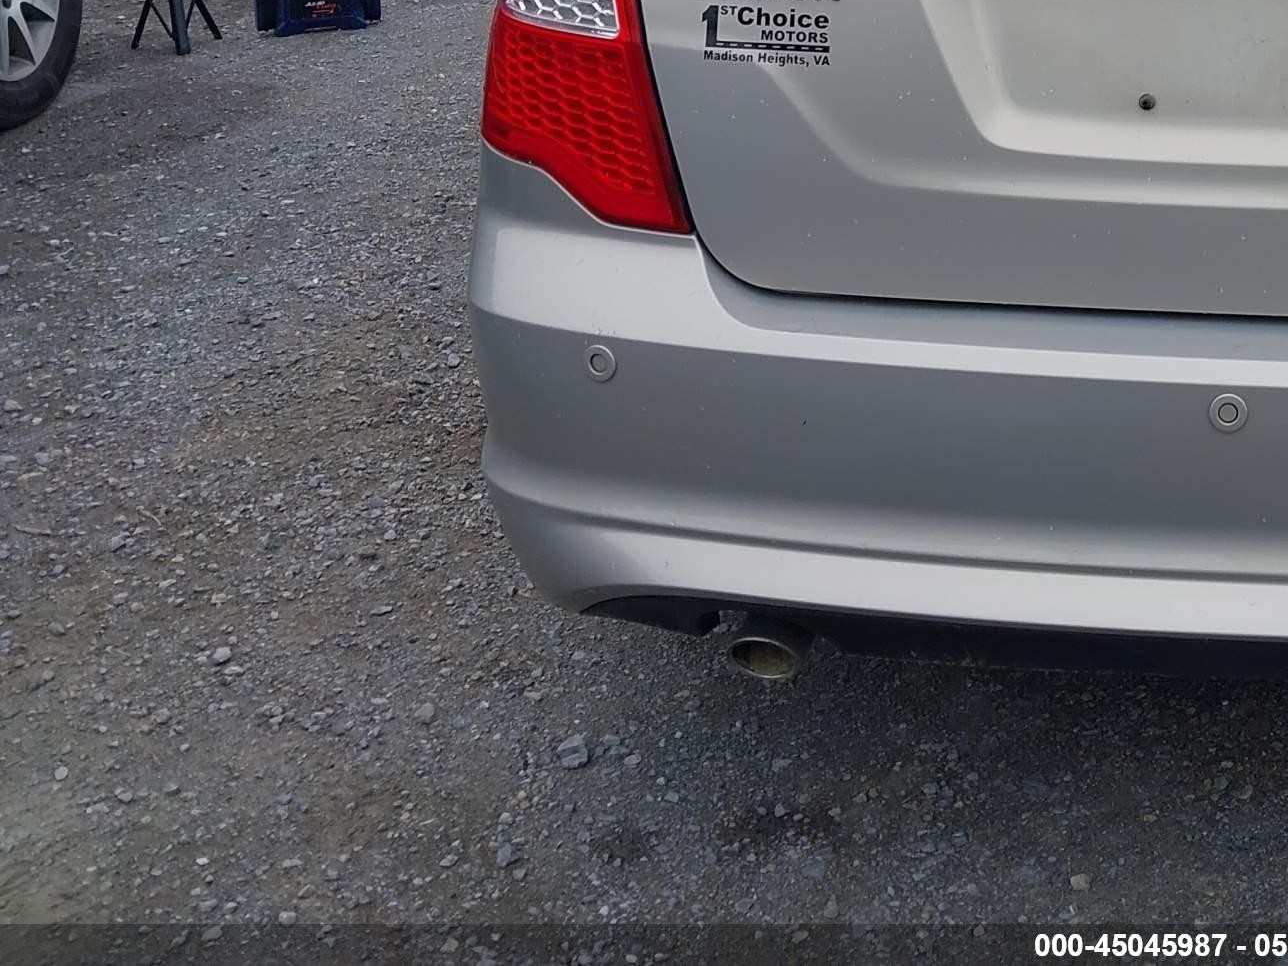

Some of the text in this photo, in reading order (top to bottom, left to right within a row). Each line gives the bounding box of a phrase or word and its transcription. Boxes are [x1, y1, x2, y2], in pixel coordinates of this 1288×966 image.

[737, 6, 830, 29] Choice
[761, 29, 829, 44] MOTORS
[703, 50, 831, 68] Madison Heights, VA
